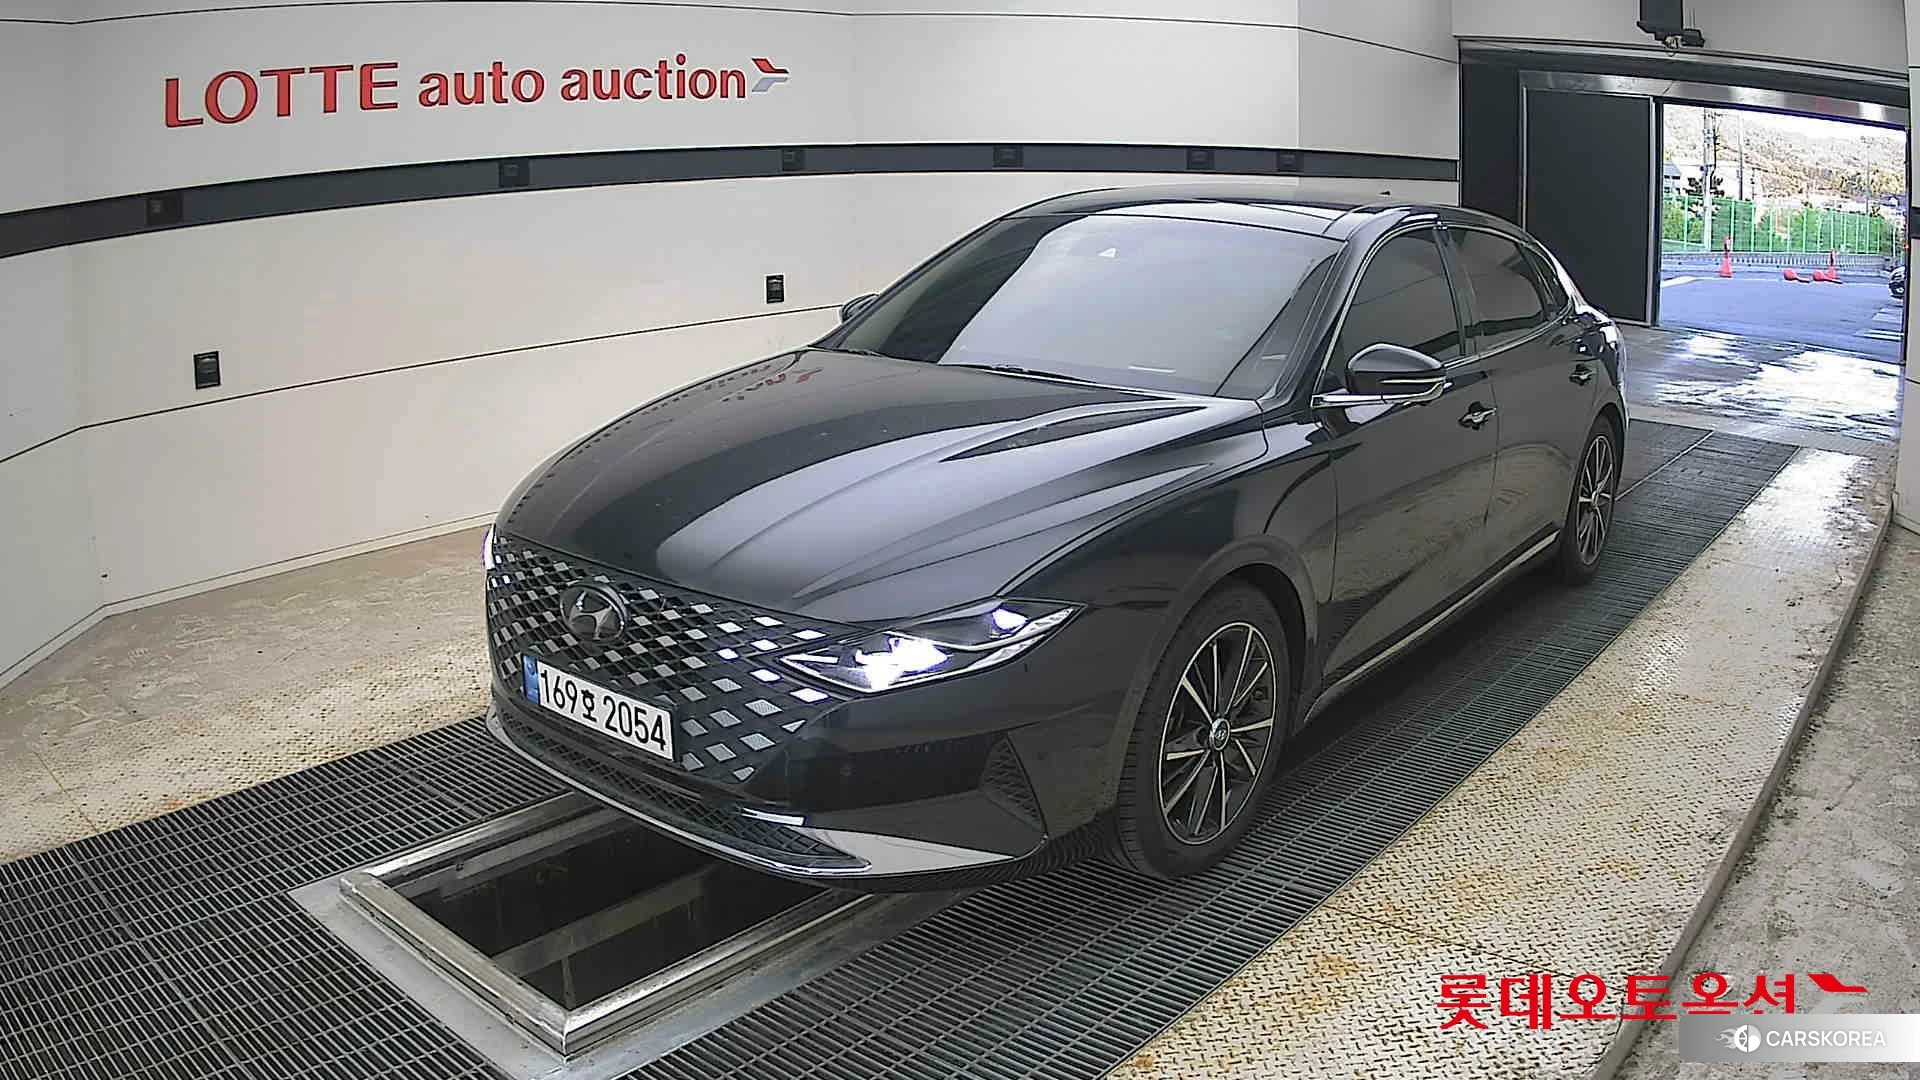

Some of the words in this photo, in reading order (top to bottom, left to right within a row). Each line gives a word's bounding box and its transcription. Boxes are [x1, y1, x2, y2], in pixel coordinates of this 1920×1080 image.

[165, 62, 399, 128] LOTTE
[418, 61, 545, 107] auto
[560, 53, 746, 101] auction
[603, 695, 666, 751] 2054
